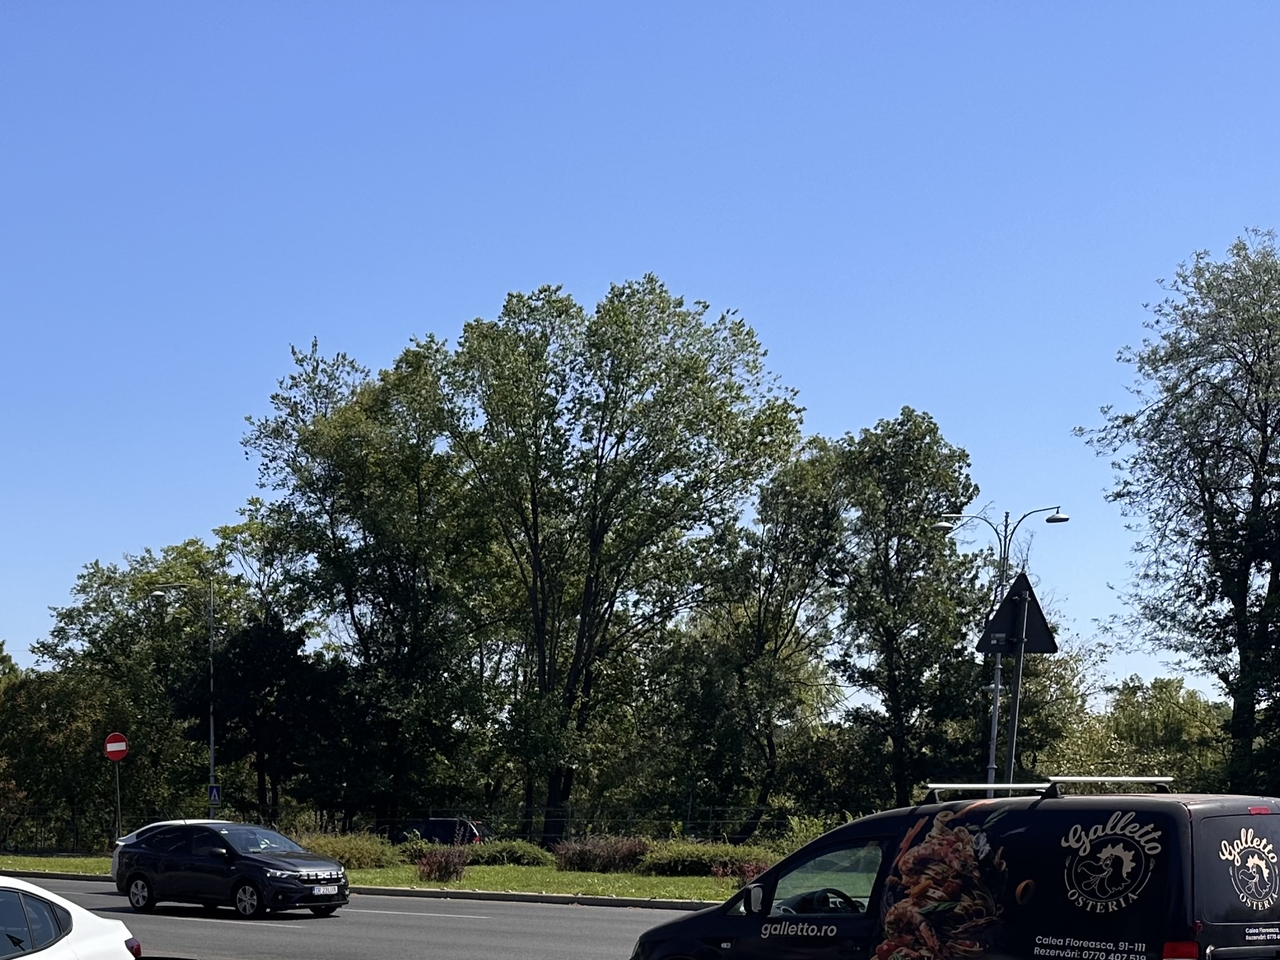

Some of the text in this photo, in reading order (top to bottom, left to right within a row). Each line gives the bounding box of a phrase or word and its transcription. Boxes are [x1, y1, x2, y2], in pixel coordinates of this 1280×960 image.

[1061, 811, 1162, 856] Galletto
[1219, 828, 1278, 866] Galletto
[1067, 889, 1138, 913] OSTERIA
[1239, 893, 1278, 910] OSTERIA
[761, 921, 837, 938] galletto.ro
[1035, 935, 1063, 946] Calea
[1065, 938, 1116, 951] Floreasca,
[1034, 947, 1081, 958] Rezervări:
[1082, 951, 1106, 960] 0770
